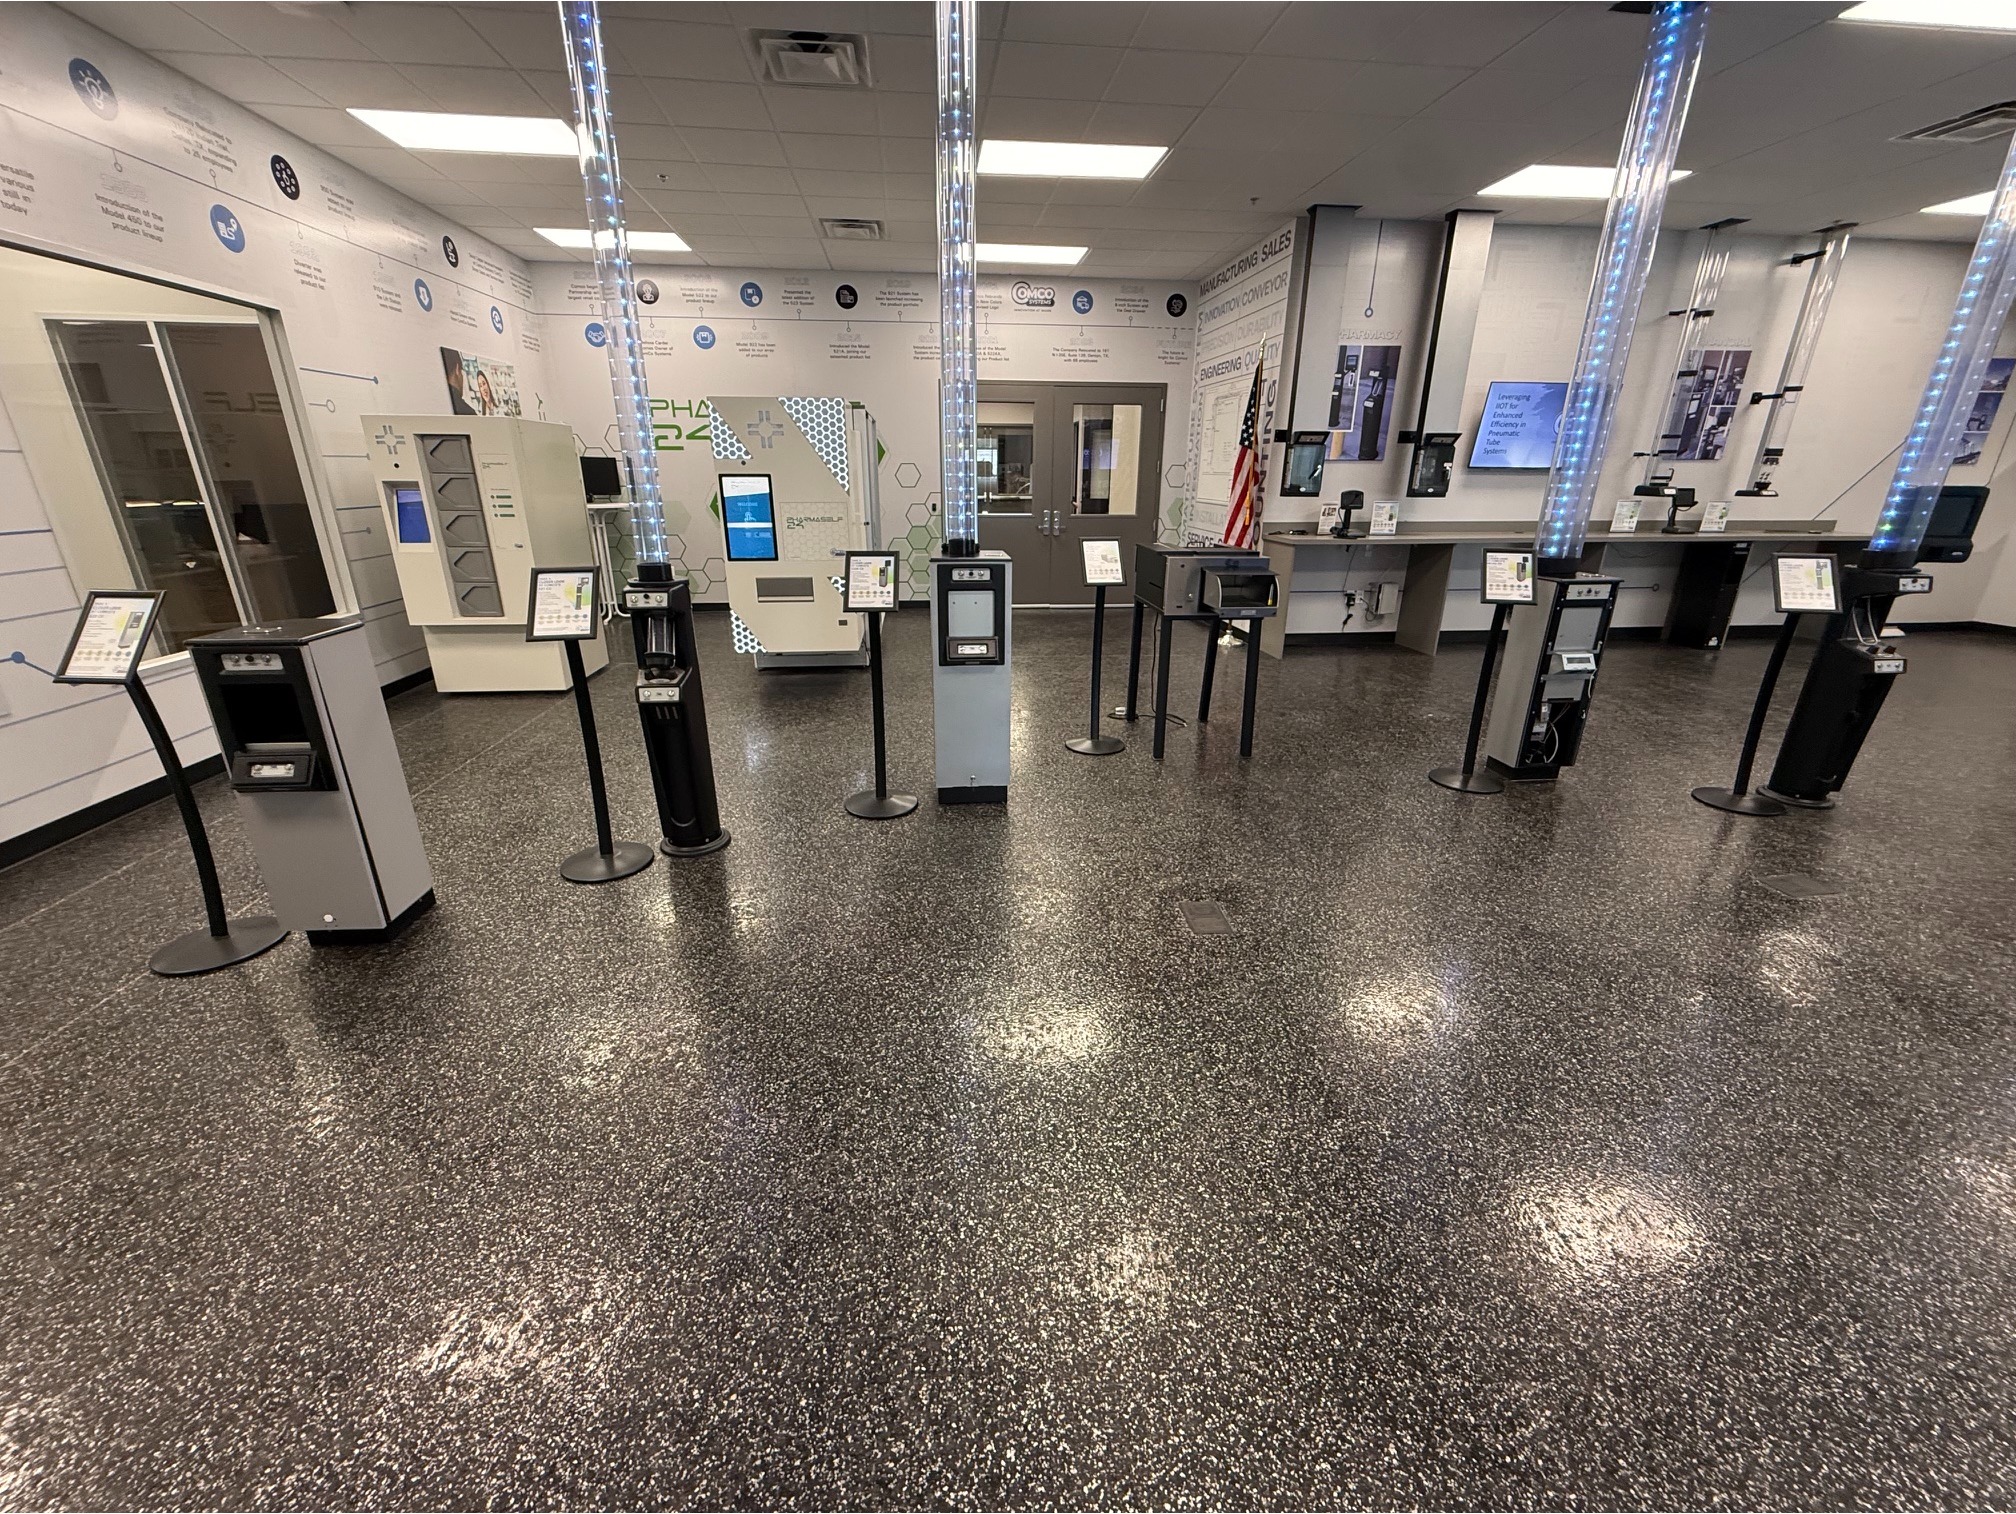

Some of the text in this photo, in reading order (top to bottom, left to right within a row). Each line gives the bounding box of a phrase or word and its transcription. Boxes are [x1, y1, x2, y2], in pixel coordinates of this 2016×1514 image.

[1199, 229, 1292, 298] MANUFACTURING SALES
[1011, 281, 1056, 306] COMCO
[1204, 271, 1288, 324] INNOVATION CONVEYOR
[1200, 356, 1242, 382] ENGINEERING
[1498, 393, 1531, 402] Leveraging
[1509, 402, 1519, 410] for
[1493, 411, 1523, 419] Enhanced
[1490, 420, 1527, 429] Efficiency in
[1488, 429, 1521, 437] Pneumatic
[1486, 438, 1501, 446] Tube
[1482, 447, 1507, 455] Systems
[1252, 379, 1278, 547] OUNTING
